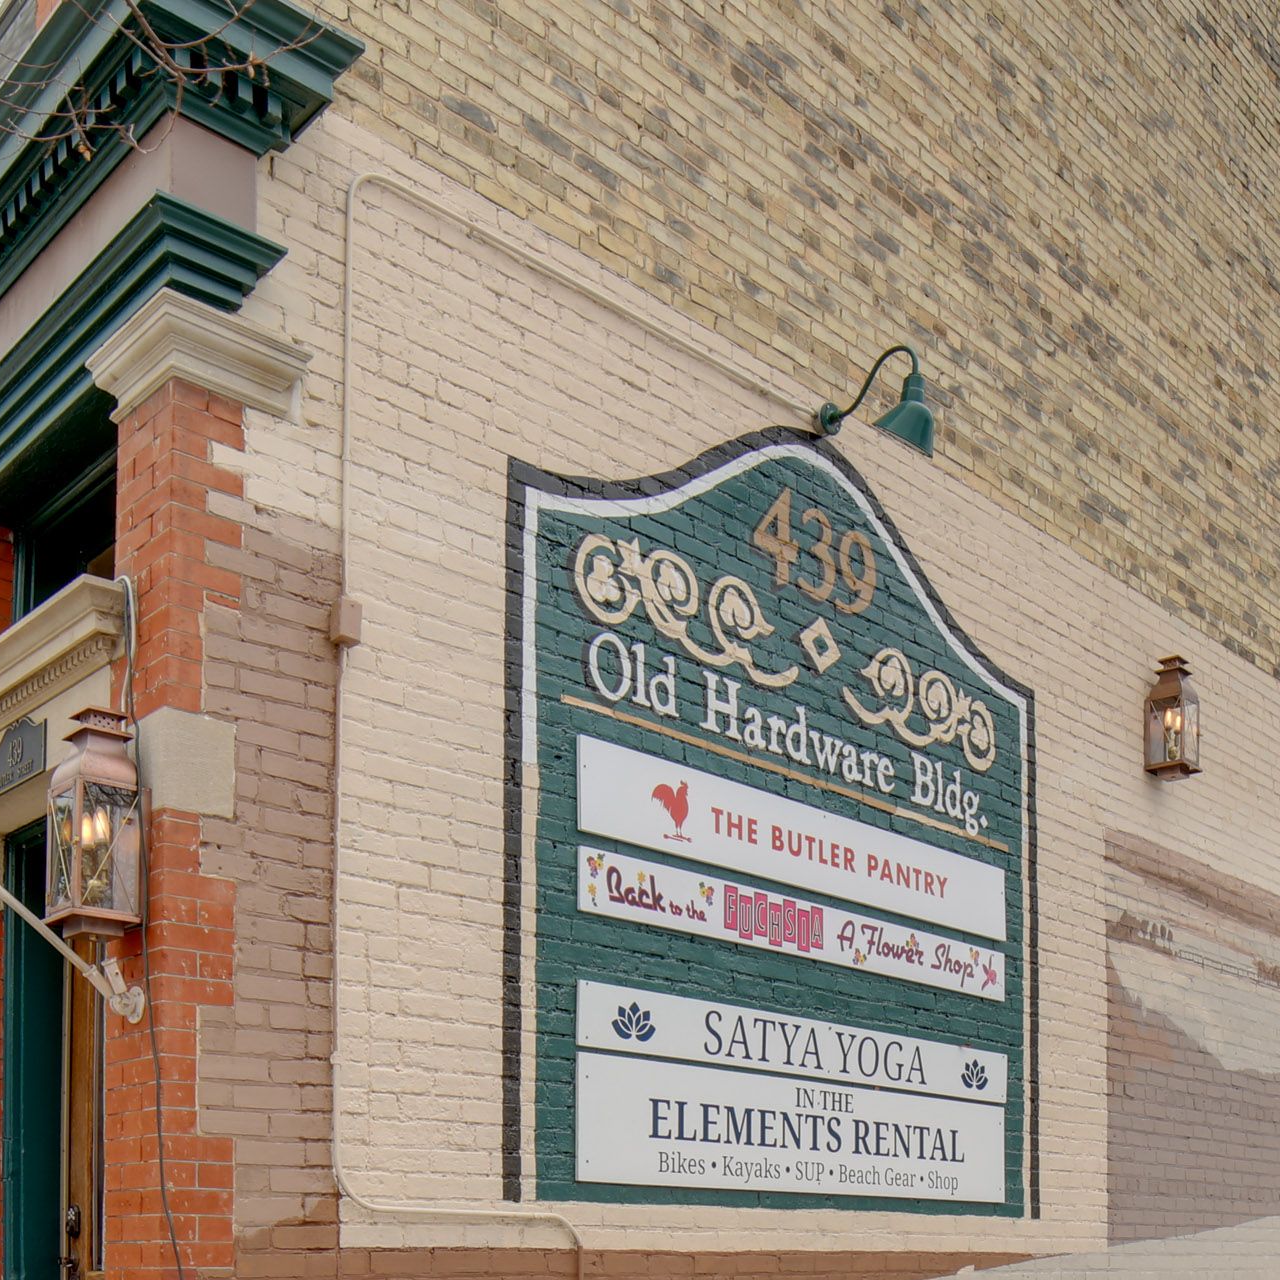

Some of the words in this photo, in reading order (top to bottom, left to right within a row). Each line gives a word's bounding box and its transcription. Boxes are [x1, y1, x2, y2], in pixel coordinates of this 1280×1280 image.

[753, 487, 877, 614] 439
[8, 736, 23, 767] 439
[588, 632, 679, 718] Old
[700, 671, 896, 794] Hardware
[910, 754, 988, 836] Bldg.
[711, 806, 758, 845] THE
[772, 829, 857, 874] BUTLER
[867, 853, 949, 899] PANTRY
[606, 864, 666, 914] Back
[669, 898, 684, 916] to
[686, 899, 707, 922] the
[725, 886, 824, 950] FUCHSIA
[837, 920, 856, 951] A
[860, 925, 925, 967] Flower
[931, 943, 976, 988] Shop
[704, 1010, 824, 1069] SATYA
[837, 1030, 928, 1086] YOGA
[648, 1098, 842, 1153] ELEMENTS
[852, 1119, 965, 1164] RENTAL
[795, 1087, 815, 1109] IN
[819, 1090, 854, 1114] THE
[658, 1151, 706, 1176] Bikes
[722, 1155, 781, 1183] Kayaks
[795, 1161, 825, 1182] SUP
[838, 1164, 881, 1186] Beach
[884, 1167, 916, 1188] Gear
[927, 1170, 959, 1195] Shop
